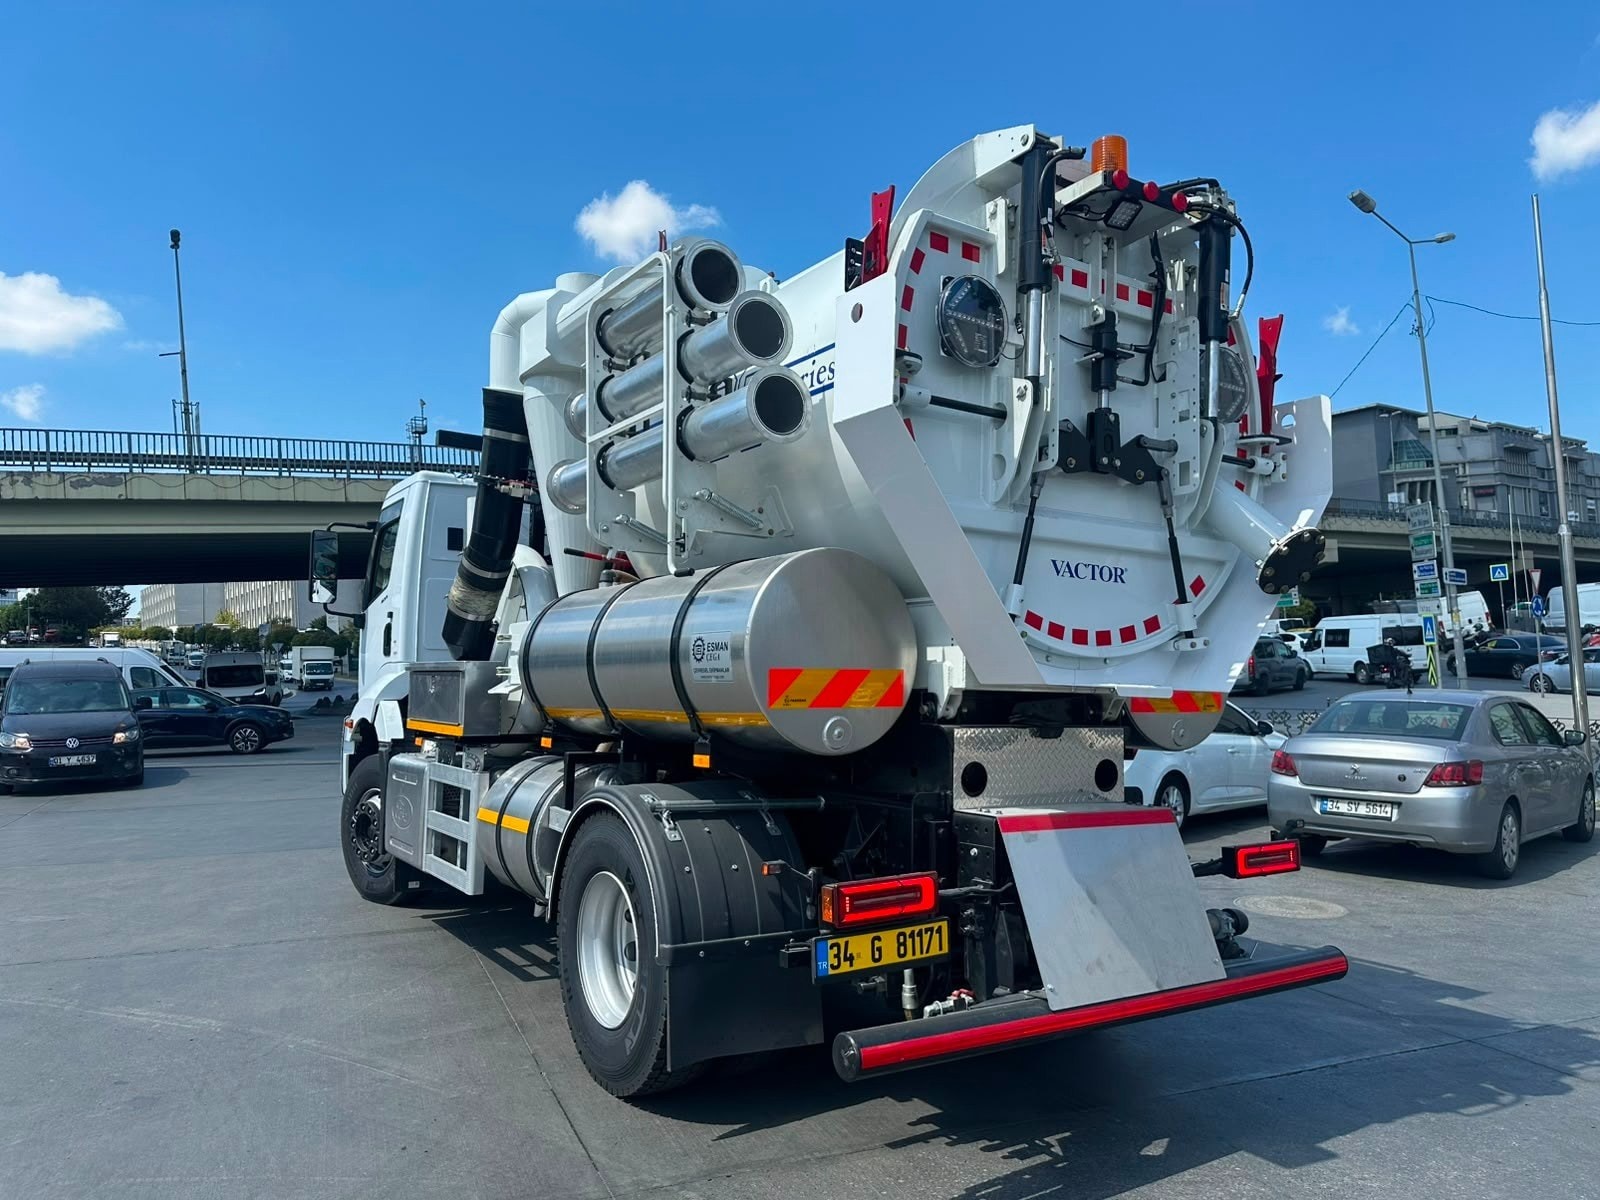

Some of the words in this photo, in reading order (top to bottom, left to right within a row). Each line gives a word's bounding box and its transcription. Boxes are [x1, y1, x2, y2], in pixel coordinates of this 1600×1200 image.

[1050, 559, 1126, 584] VACTOR
[706, 641, 729, 652] ESMAN
[1328, 799, 1340, 811] 34
[1346, 801, 1360, 813] SV
[1365, 802, 1389, 815] 5614
[817, 961, 828, 970] TR
[829, 940, 855, 971] 34
[870, 935, 883, 963] G
[896, 925, 943, 959] 81171
